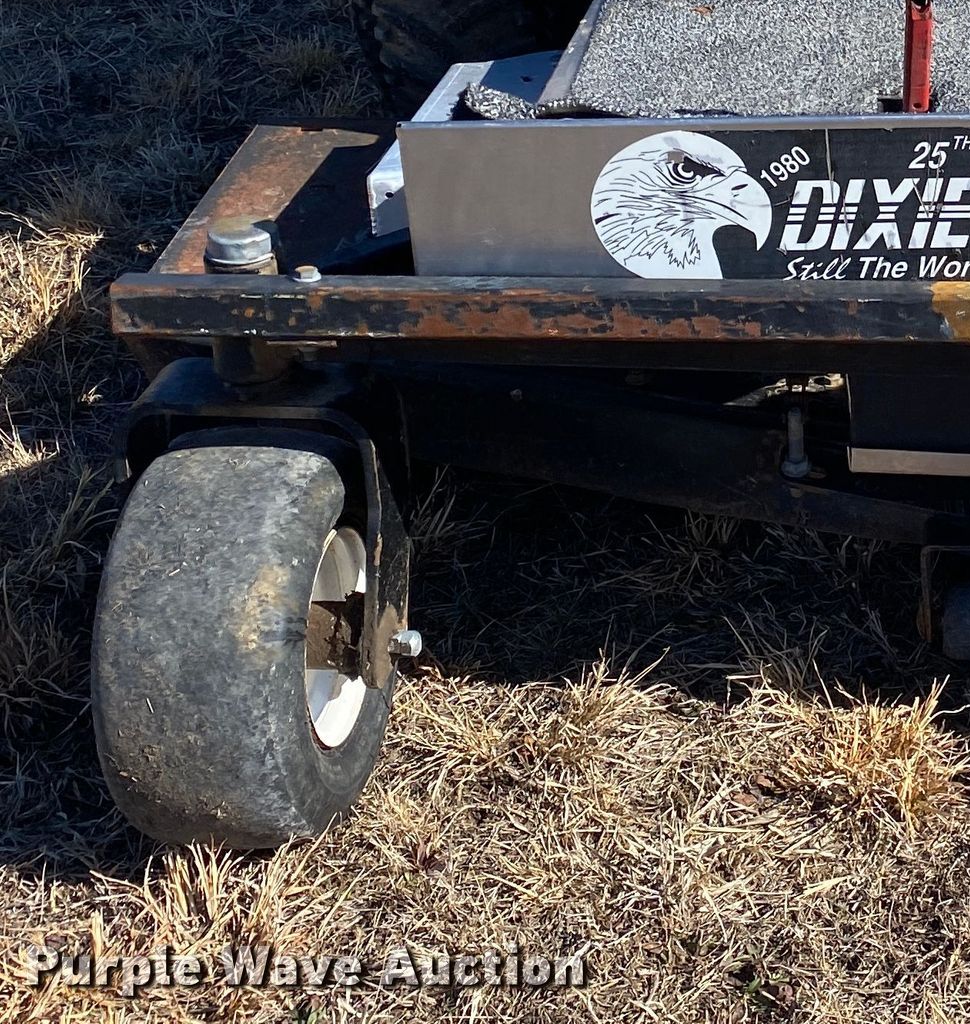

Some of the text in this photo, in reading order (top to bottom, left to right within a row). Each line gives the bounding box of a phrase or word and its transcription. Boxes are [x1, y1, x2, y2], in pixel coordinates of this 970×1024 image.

[760, 145, 811, 188] 1980
[783, 256, 848, 281] Still
[858, 256, 909, 279] The
